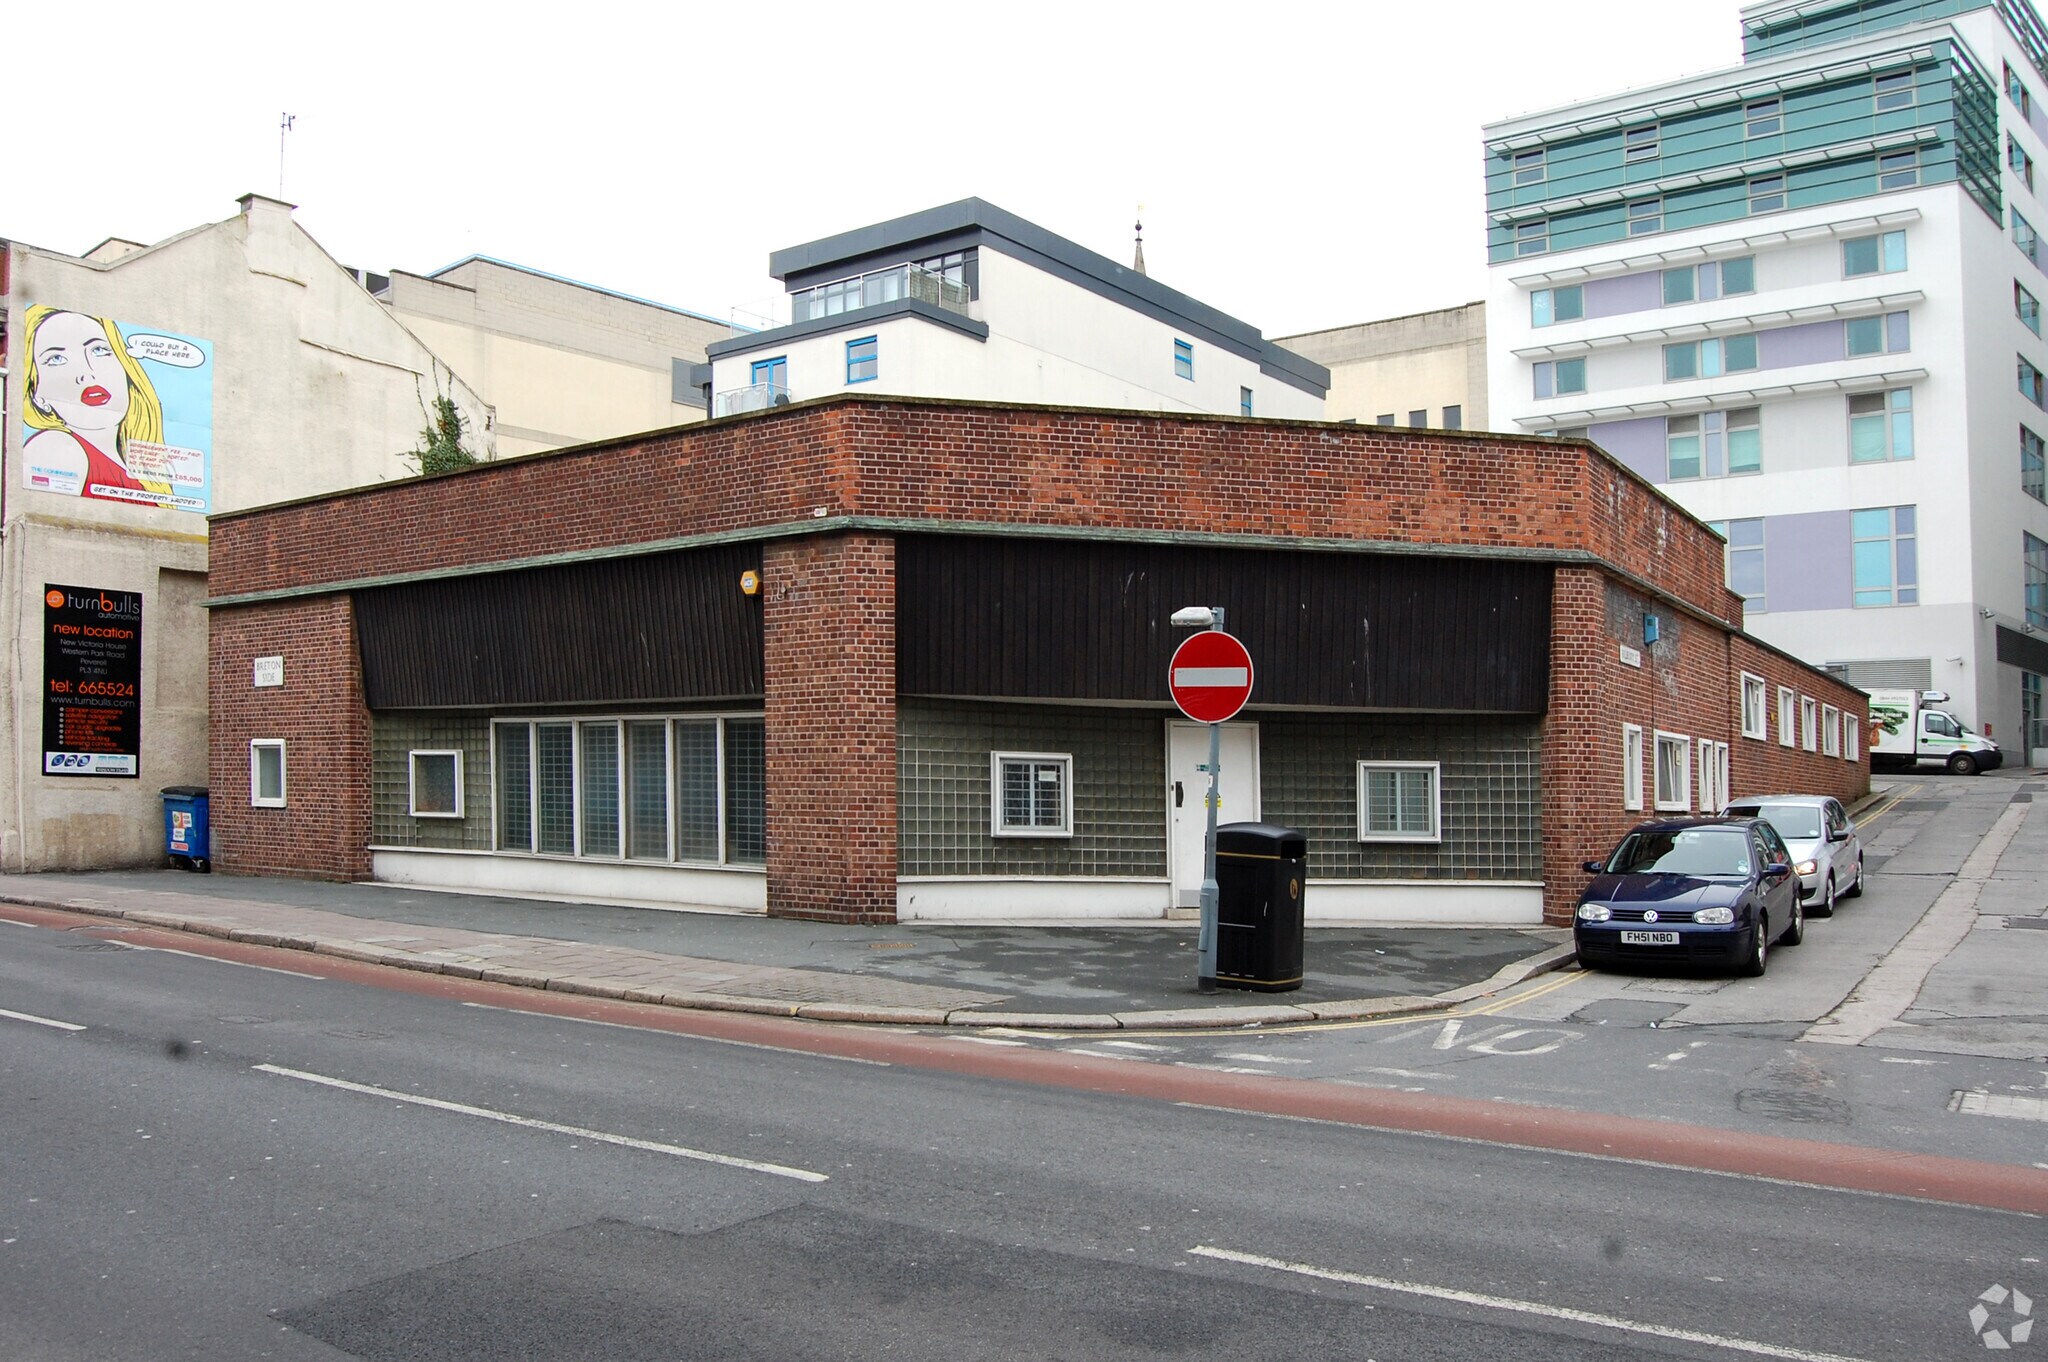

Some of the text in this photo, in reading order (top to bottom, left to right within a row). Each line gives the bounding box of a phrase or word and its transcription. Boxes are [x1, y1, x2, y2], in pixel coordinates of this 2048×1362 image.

[141, 340, 165, 349] COULD
[146, 348, 169, 356] PLACE
[137, 492, 168, 502] PROPERTY
[68, 592, 140, 614] turnbulls
[98, 612, 139, 621] automotive
[53, 624, 133, 639] new location
[78, 639, 104, 648] Victoria
[61, 648, 89, 656] Western
[80, 658, 107, 666] Peverell
[257, 660, 281, 671] BRETON
[262, 673, 275, 682] SIDE
[50, 679, 134, 696] tel: 665524
[51, 697, 135, 708] www.turnbulls.com
[1627, 933, 1673, 942] FH51 NBO
